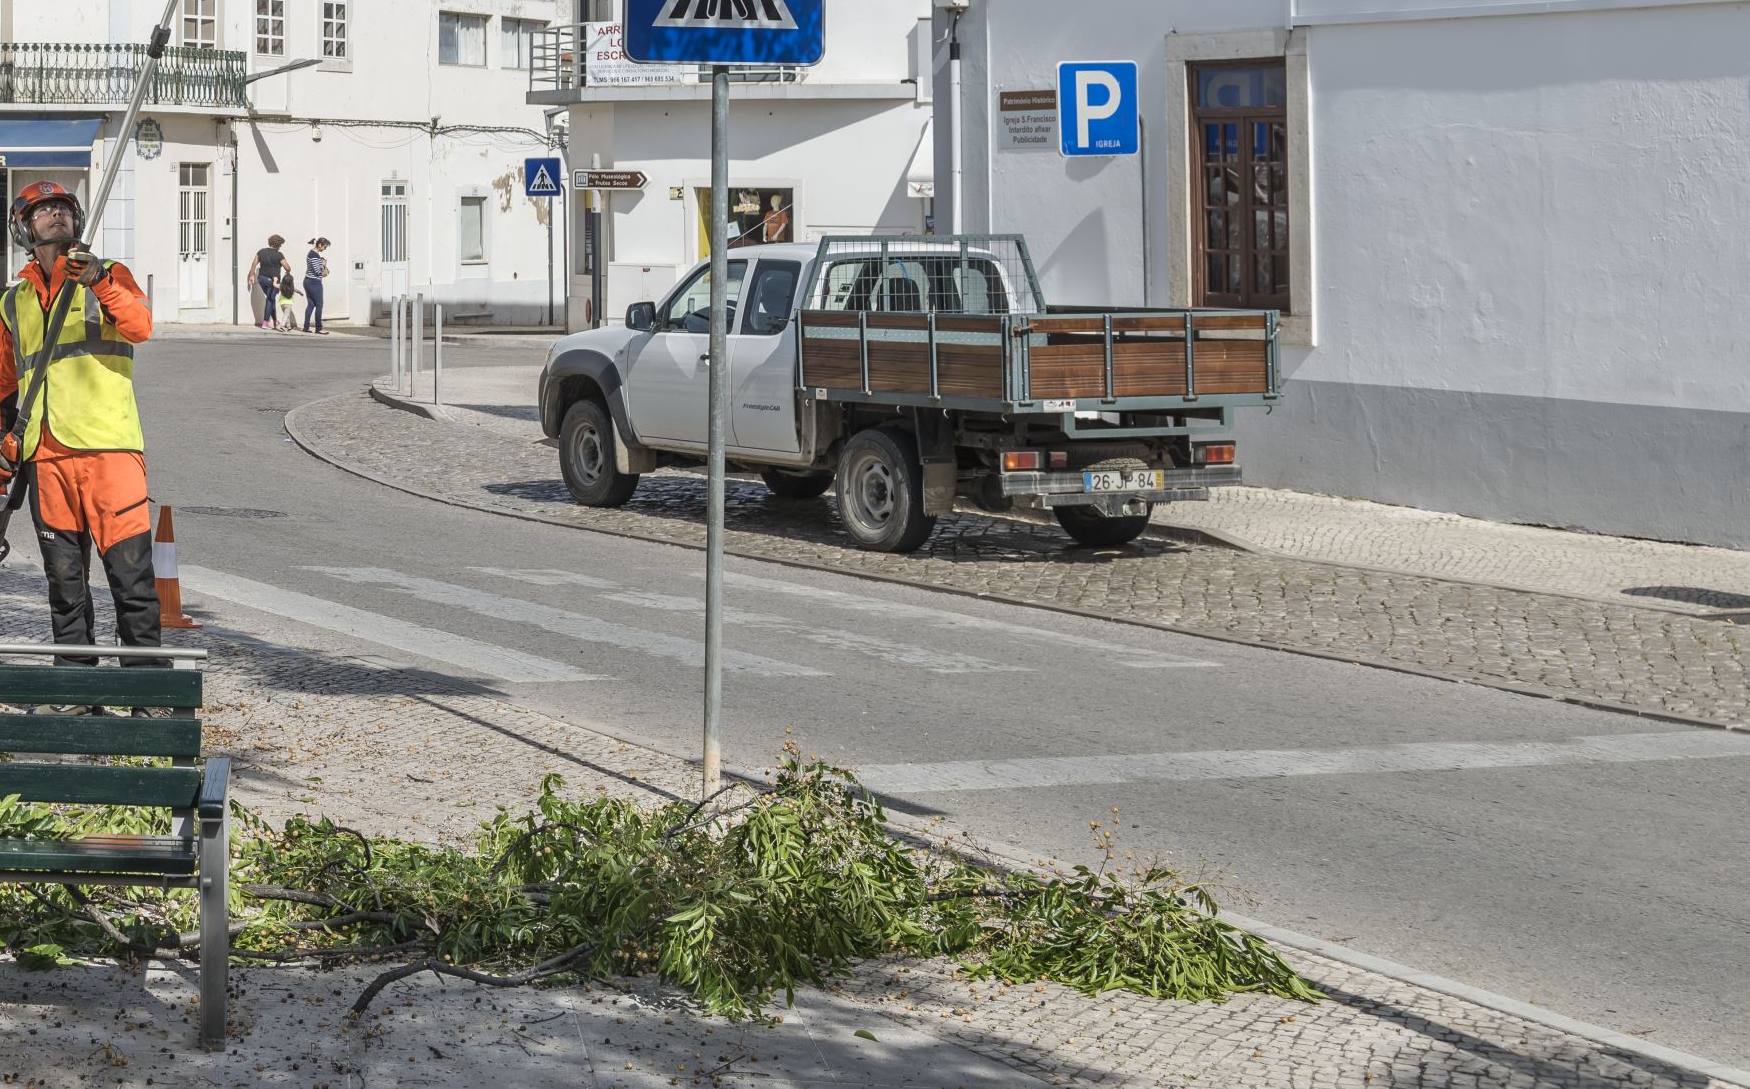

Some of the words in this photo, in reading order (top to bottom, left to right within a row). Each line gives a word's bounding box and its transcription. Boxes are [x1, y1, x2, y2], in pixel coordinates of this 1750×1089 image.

[598, 26, 621, 36] ARR
[1003, 97, 1031, 106] Património
[1075, 70, 1122, 148] P
[1003, 116, 1020, 125] Igreja
[1008, 126, 1034, 134] Interdito
[1013, 135, 1048, 144] Publicidade
[1095, 140, 1121, 148] IGREJA
